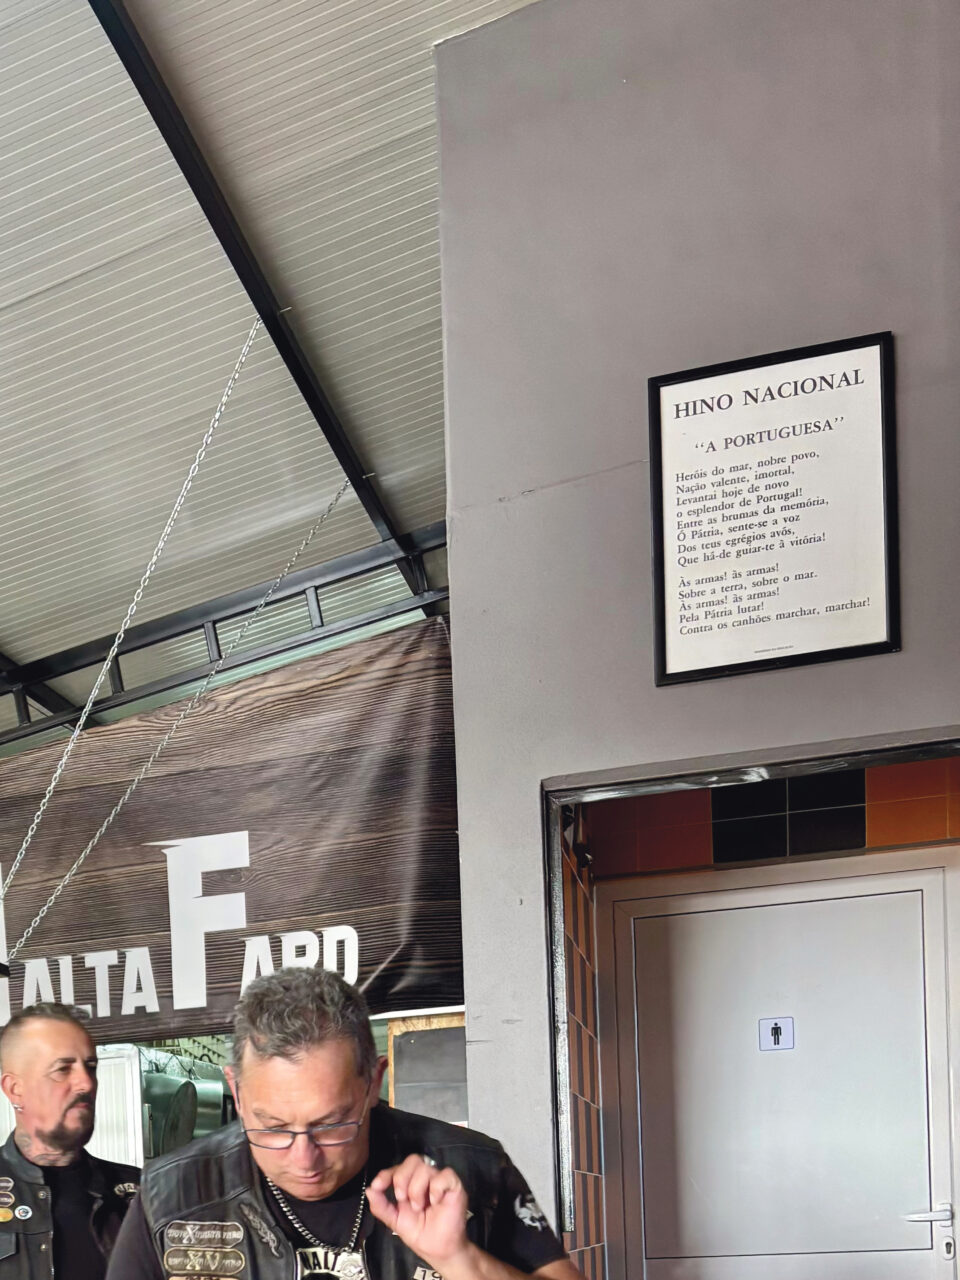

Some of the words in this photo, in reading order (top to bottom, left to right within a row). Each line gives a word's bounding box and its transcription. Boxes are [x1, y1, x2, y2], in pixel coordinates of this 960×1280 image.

[673, 394, 733, 419] HINO
[743, 369, 865, 406] NACIONAL
[676, 470, 707, 482] Heróis
[712, 466, 724, 476] do
[730, 463, 752, 472] mar,
[758, 456, 786, 467] nobre
[791, 451, 819, 463] povo,
[676, 484, 706, 494] Nação
[711, 476, 749, 488] valente,
[755, 466, 794, 480] imortal,
[677, 490, 716, 506] Levantai
[722, 488, 743, 498] hoje
[748, 484, 760, 494] de
[765, 481, 789, 490] novo
[687, 502, 735, 517] esplendor
[740, 498, 751, 507] de
[757, 488, 802, 504] Portugal!
[677, 519, 702, 529] Entre
[722, 510, 758, 522] brumas
[763, 505, 775, 514] da
[781, 497, 829, 512] memória,
[677, 530, 686, 541] Ó
[692, 526, 723, 539] Pátria,
[728, 521, 767, 533] sente-se
[784, 515, 800, 523] voz
[678, 545, 696, 553] Dos
[702, 540, 721, 549] teus
[726, 532, 765, 545] egrégios
[678, 557, 698, 567] Que
[704, 551, 731, 561] há-de
[736, 543, 774, 558] guiar-te
[790, 533, 825, 546] vitória!
[679, 577, 690, 588] Às
[695, 572, 727, 585] armas!
[746, 563, 779, 576] armas!
[679, 588, 705, 599] Sobre
[721, 583, 747, 593] terra,
[752, 576, 778, 588] sobre
[680, 601, 691, 611] Às
[696, 596, 727, 609] armas!
[747, 588, 779, 600] armas!
[680, 613, 699, 623] Pela
[704, 607, 732, 620] Pátria
[738, 602, 764, 614] lutar!
[680, 624, 713, 635] Contra
[718, 622, 727, 630] os
[732, 613, 771, 628] canhões
[776, 607, 820, 620] marchar,
[825, 597, 870, 613] marchar!
[185, 1250, 220, 1270] XV
